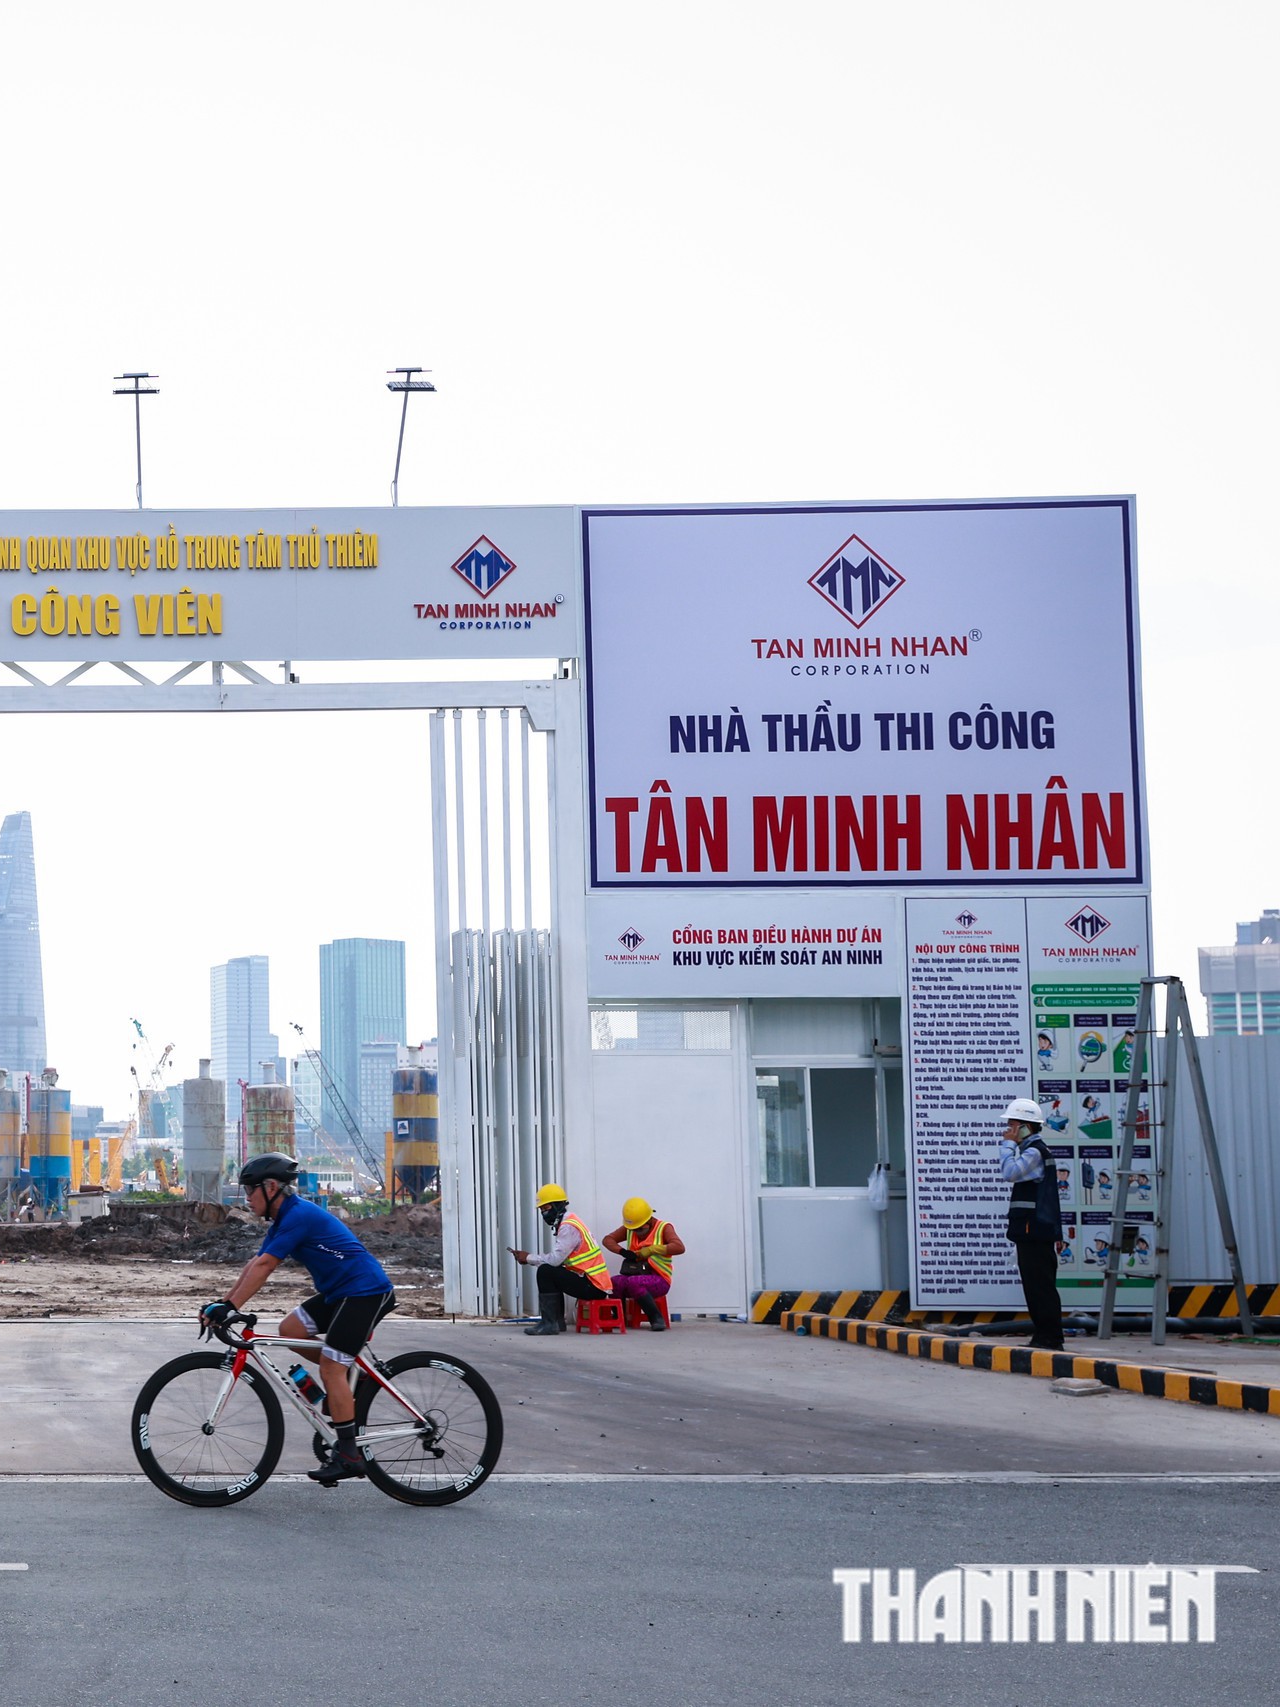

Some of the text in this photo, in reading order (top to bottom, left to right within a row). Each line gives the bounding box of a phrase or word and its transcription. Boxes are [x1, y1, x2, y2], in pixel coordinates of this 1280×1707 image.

[25, 536, 74, 576] QUAN
[74, 536, 112, 573] KHU
[114, 532, 151, 578] VỰC
[154, 524, 180, 572] HỒ
[182, 534, 242, 572] TRUNG
[244, 529, 283, 572] TÂM
[285, 526, 322, 571] THỦ
[324, 528, 378, 571] THIÊM
[11, 585, 121, 639] CÔNG
[133, 586, 223, 638] VIÊN
[413, 603, 556, 619] TAN MINH NHAN
[751, 636, 968, 658] TAN MINH NHAN
[791, 664, 929, 676] CORPORATION
[669, 700, 1055, 753] NHÀ THẦU THI CÔNG
[605, 775, 1126, 873] TÂN MINH NHÂN
[672, 924, 882, 946] CỔNG BAN ĐIỀU HÀNH DỰ ÁN
[673, 946, 882, 969] KHU VỰC KIỂM SOÁT AN NINH
[915, 943, 933, 955] NỘI
[959, 943, 986, 953] CÔNG
